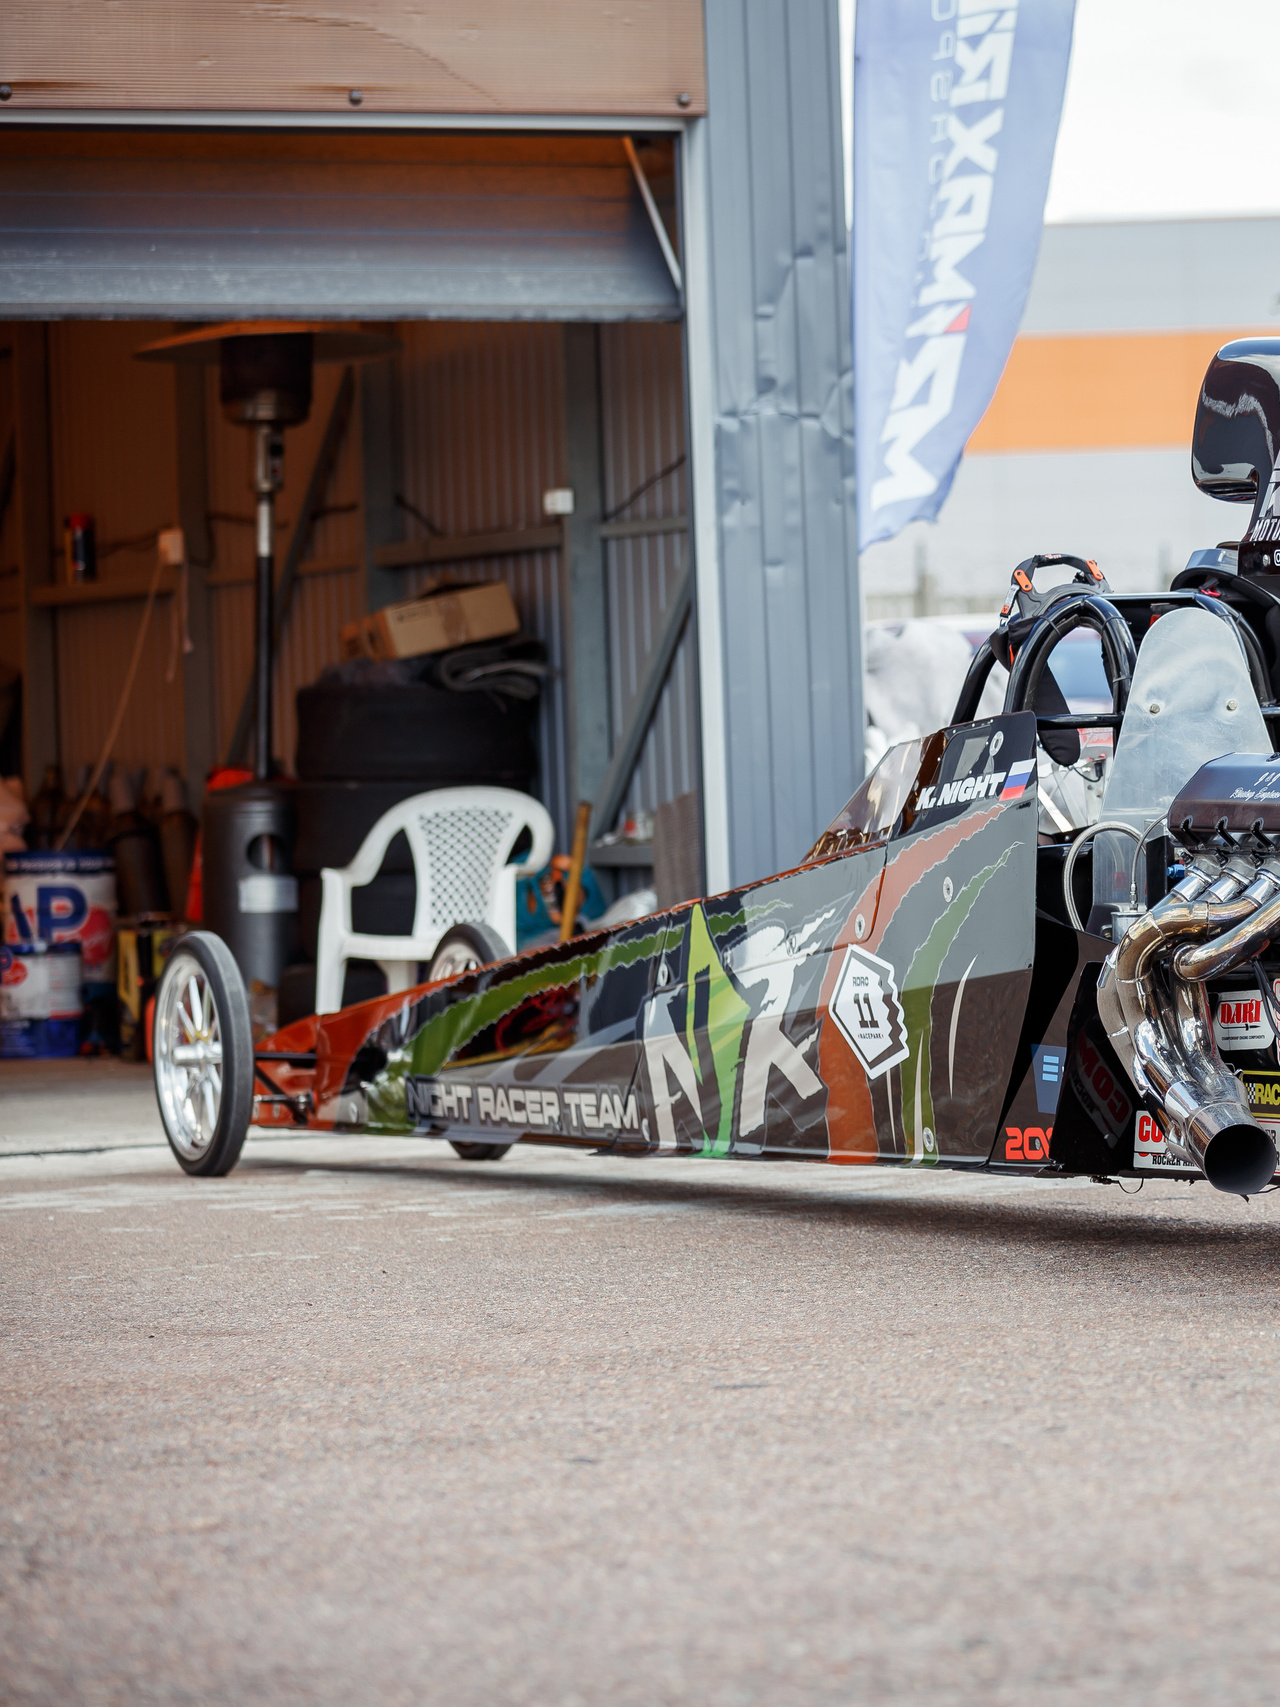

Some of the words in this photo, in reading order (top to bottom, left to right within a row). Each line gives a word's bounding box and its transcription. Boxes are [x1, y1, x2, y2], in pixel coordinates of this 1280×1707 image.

[853, 993, 880, 1029] 11
[1220, 998, 1263, 1025] DART
[407, 1076, 472, 1121] NIGHT
[477, 1084, 562, 1128] RACER
[563, 1091, 640, 1130] TEAM
[1152, 1154, 1181, 1167] ROCKER
